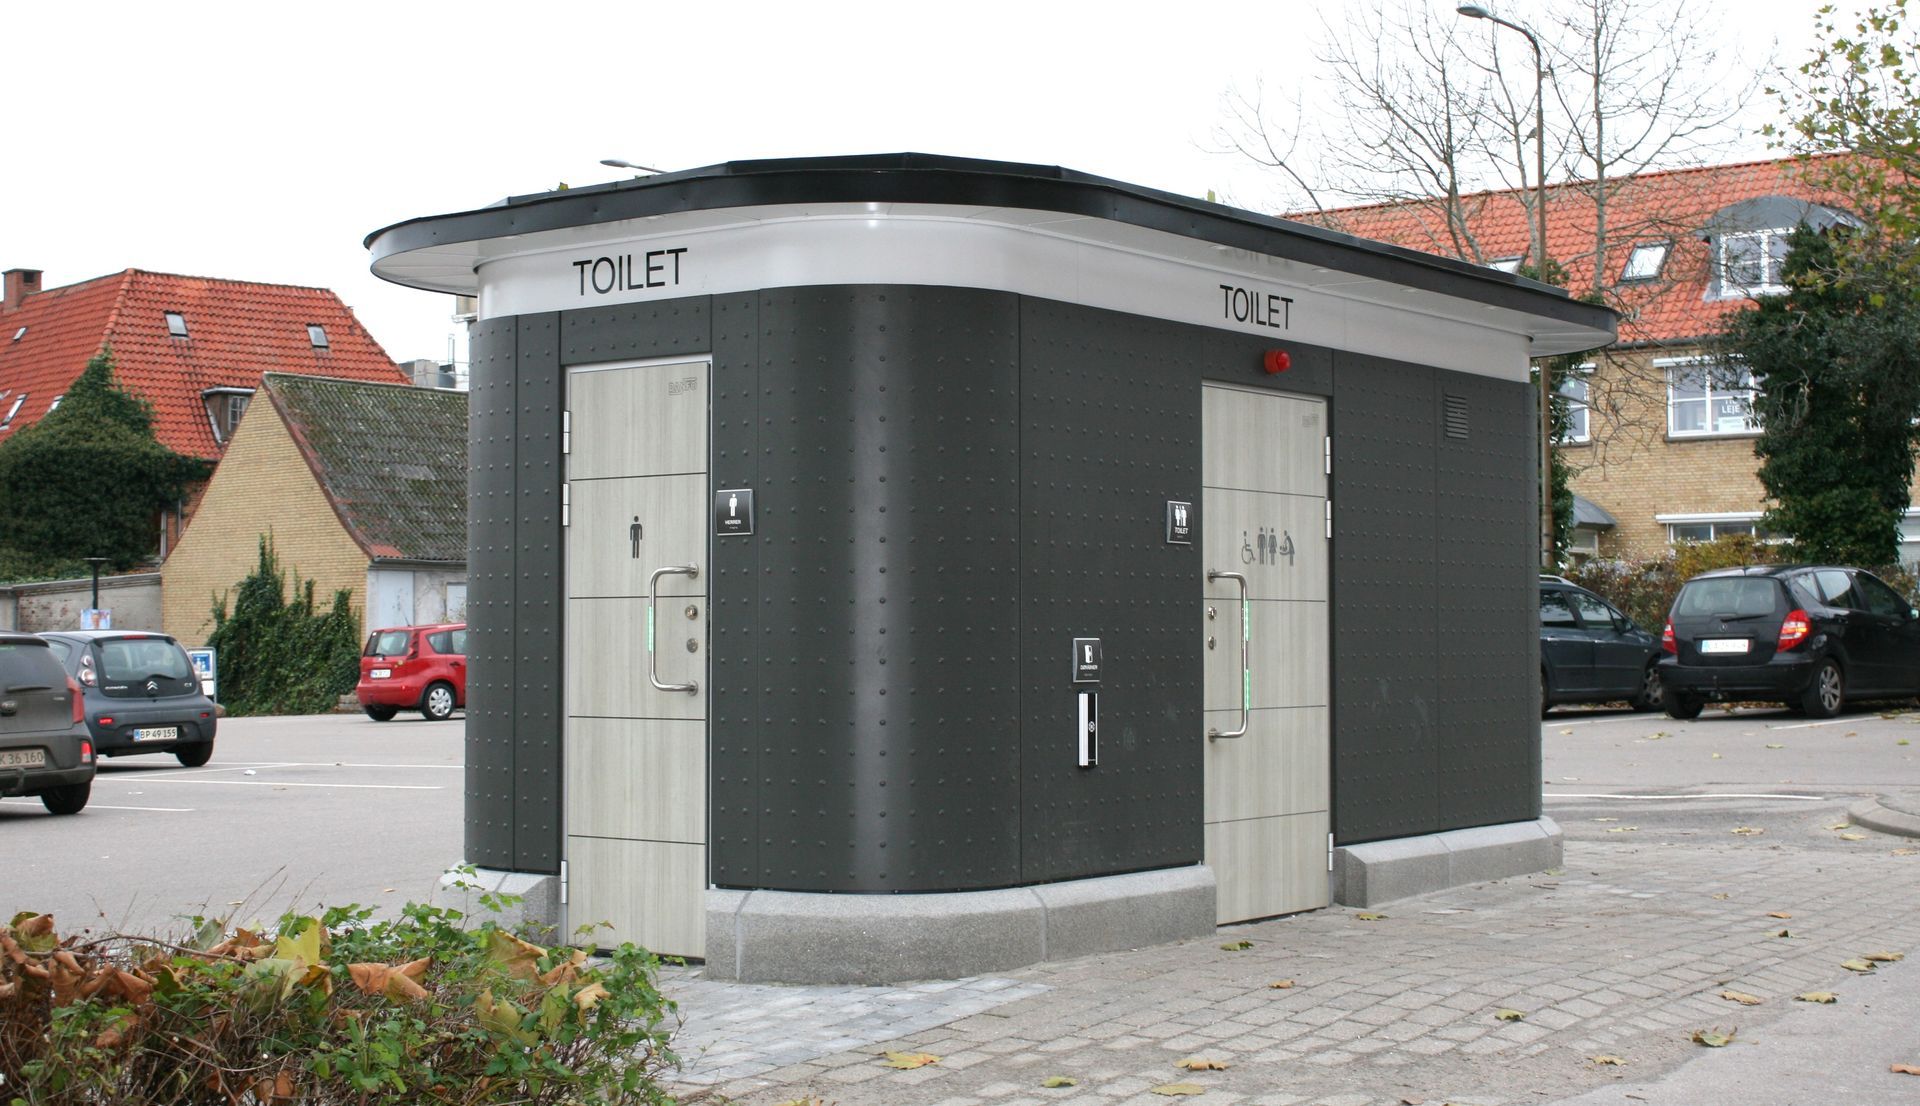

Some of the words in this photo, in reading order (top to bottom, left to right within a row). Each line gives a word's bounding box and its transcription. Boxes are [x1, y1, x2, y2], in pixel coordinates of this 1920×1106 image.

[573, 248, 688, 296] TOILET
[1219, 284, 1294, 330] TOILET
[140, 730, 151, 739] BP
[152, 729, 162, 738] 49
[24, 751, 44, 763] 160
